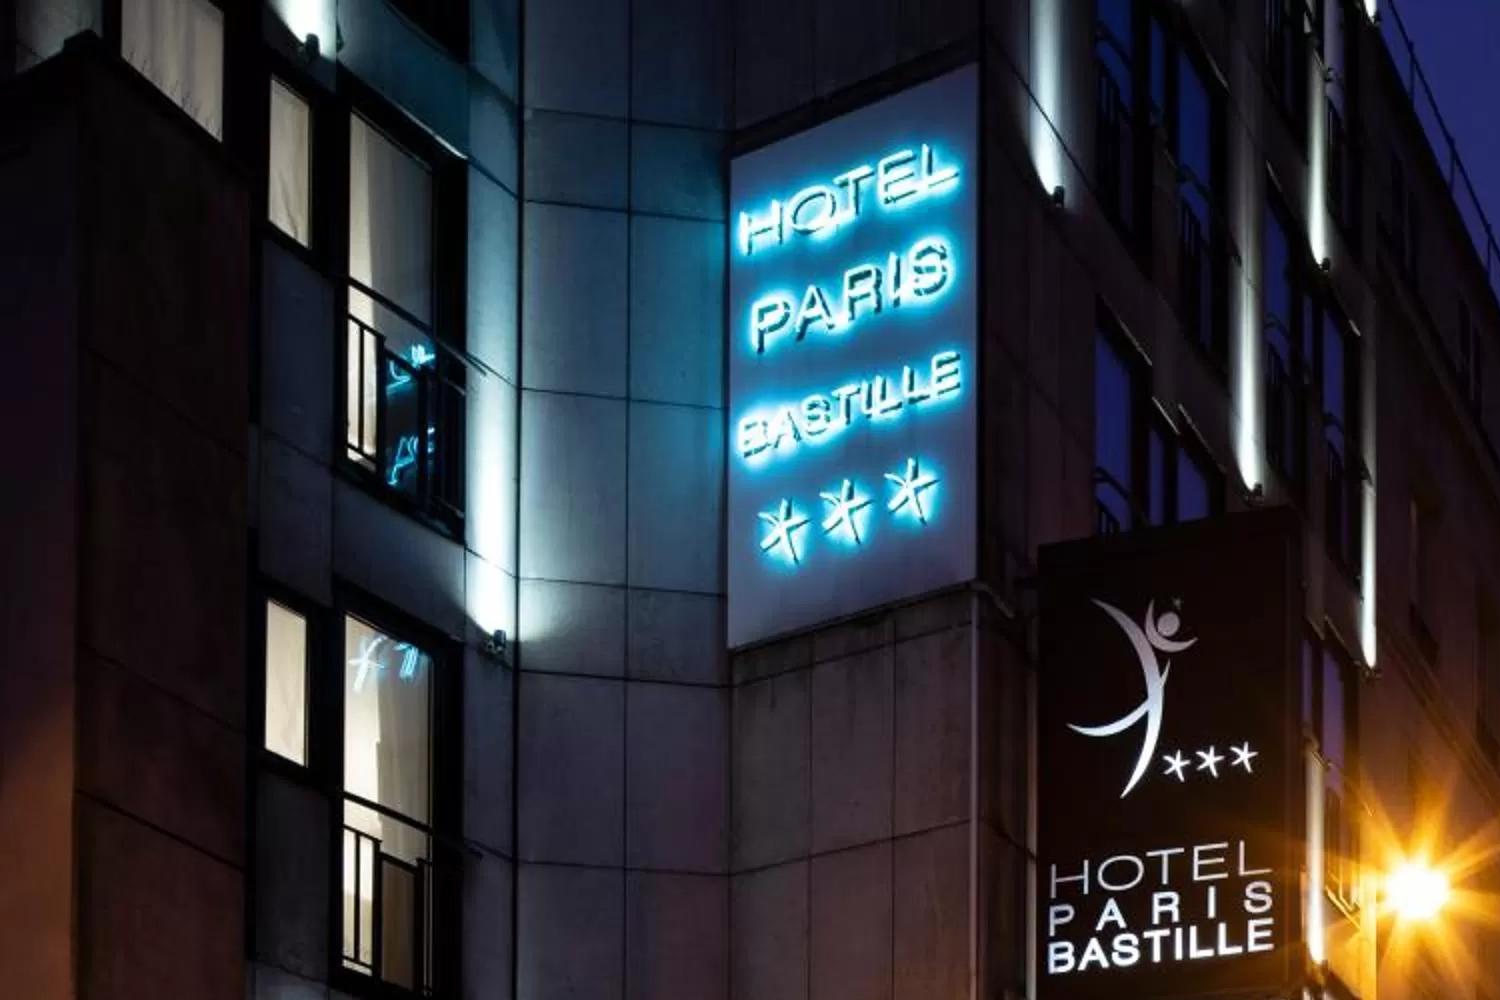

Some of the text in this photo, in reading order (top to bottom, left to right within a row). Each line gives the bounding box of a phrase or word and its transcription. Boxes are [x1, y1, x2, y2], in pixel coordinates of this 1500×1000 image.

[738, 142, 960, 256] HOTEL
[751, 238, 950, 354] PARIS
[737, 350, 961, 459] BASTILLE
[1048, 881, 1273, 936] PARIS
[1050, 840, 1273, 899] HOTEL
[1048, 918, 1275, 975] BASTILLE
